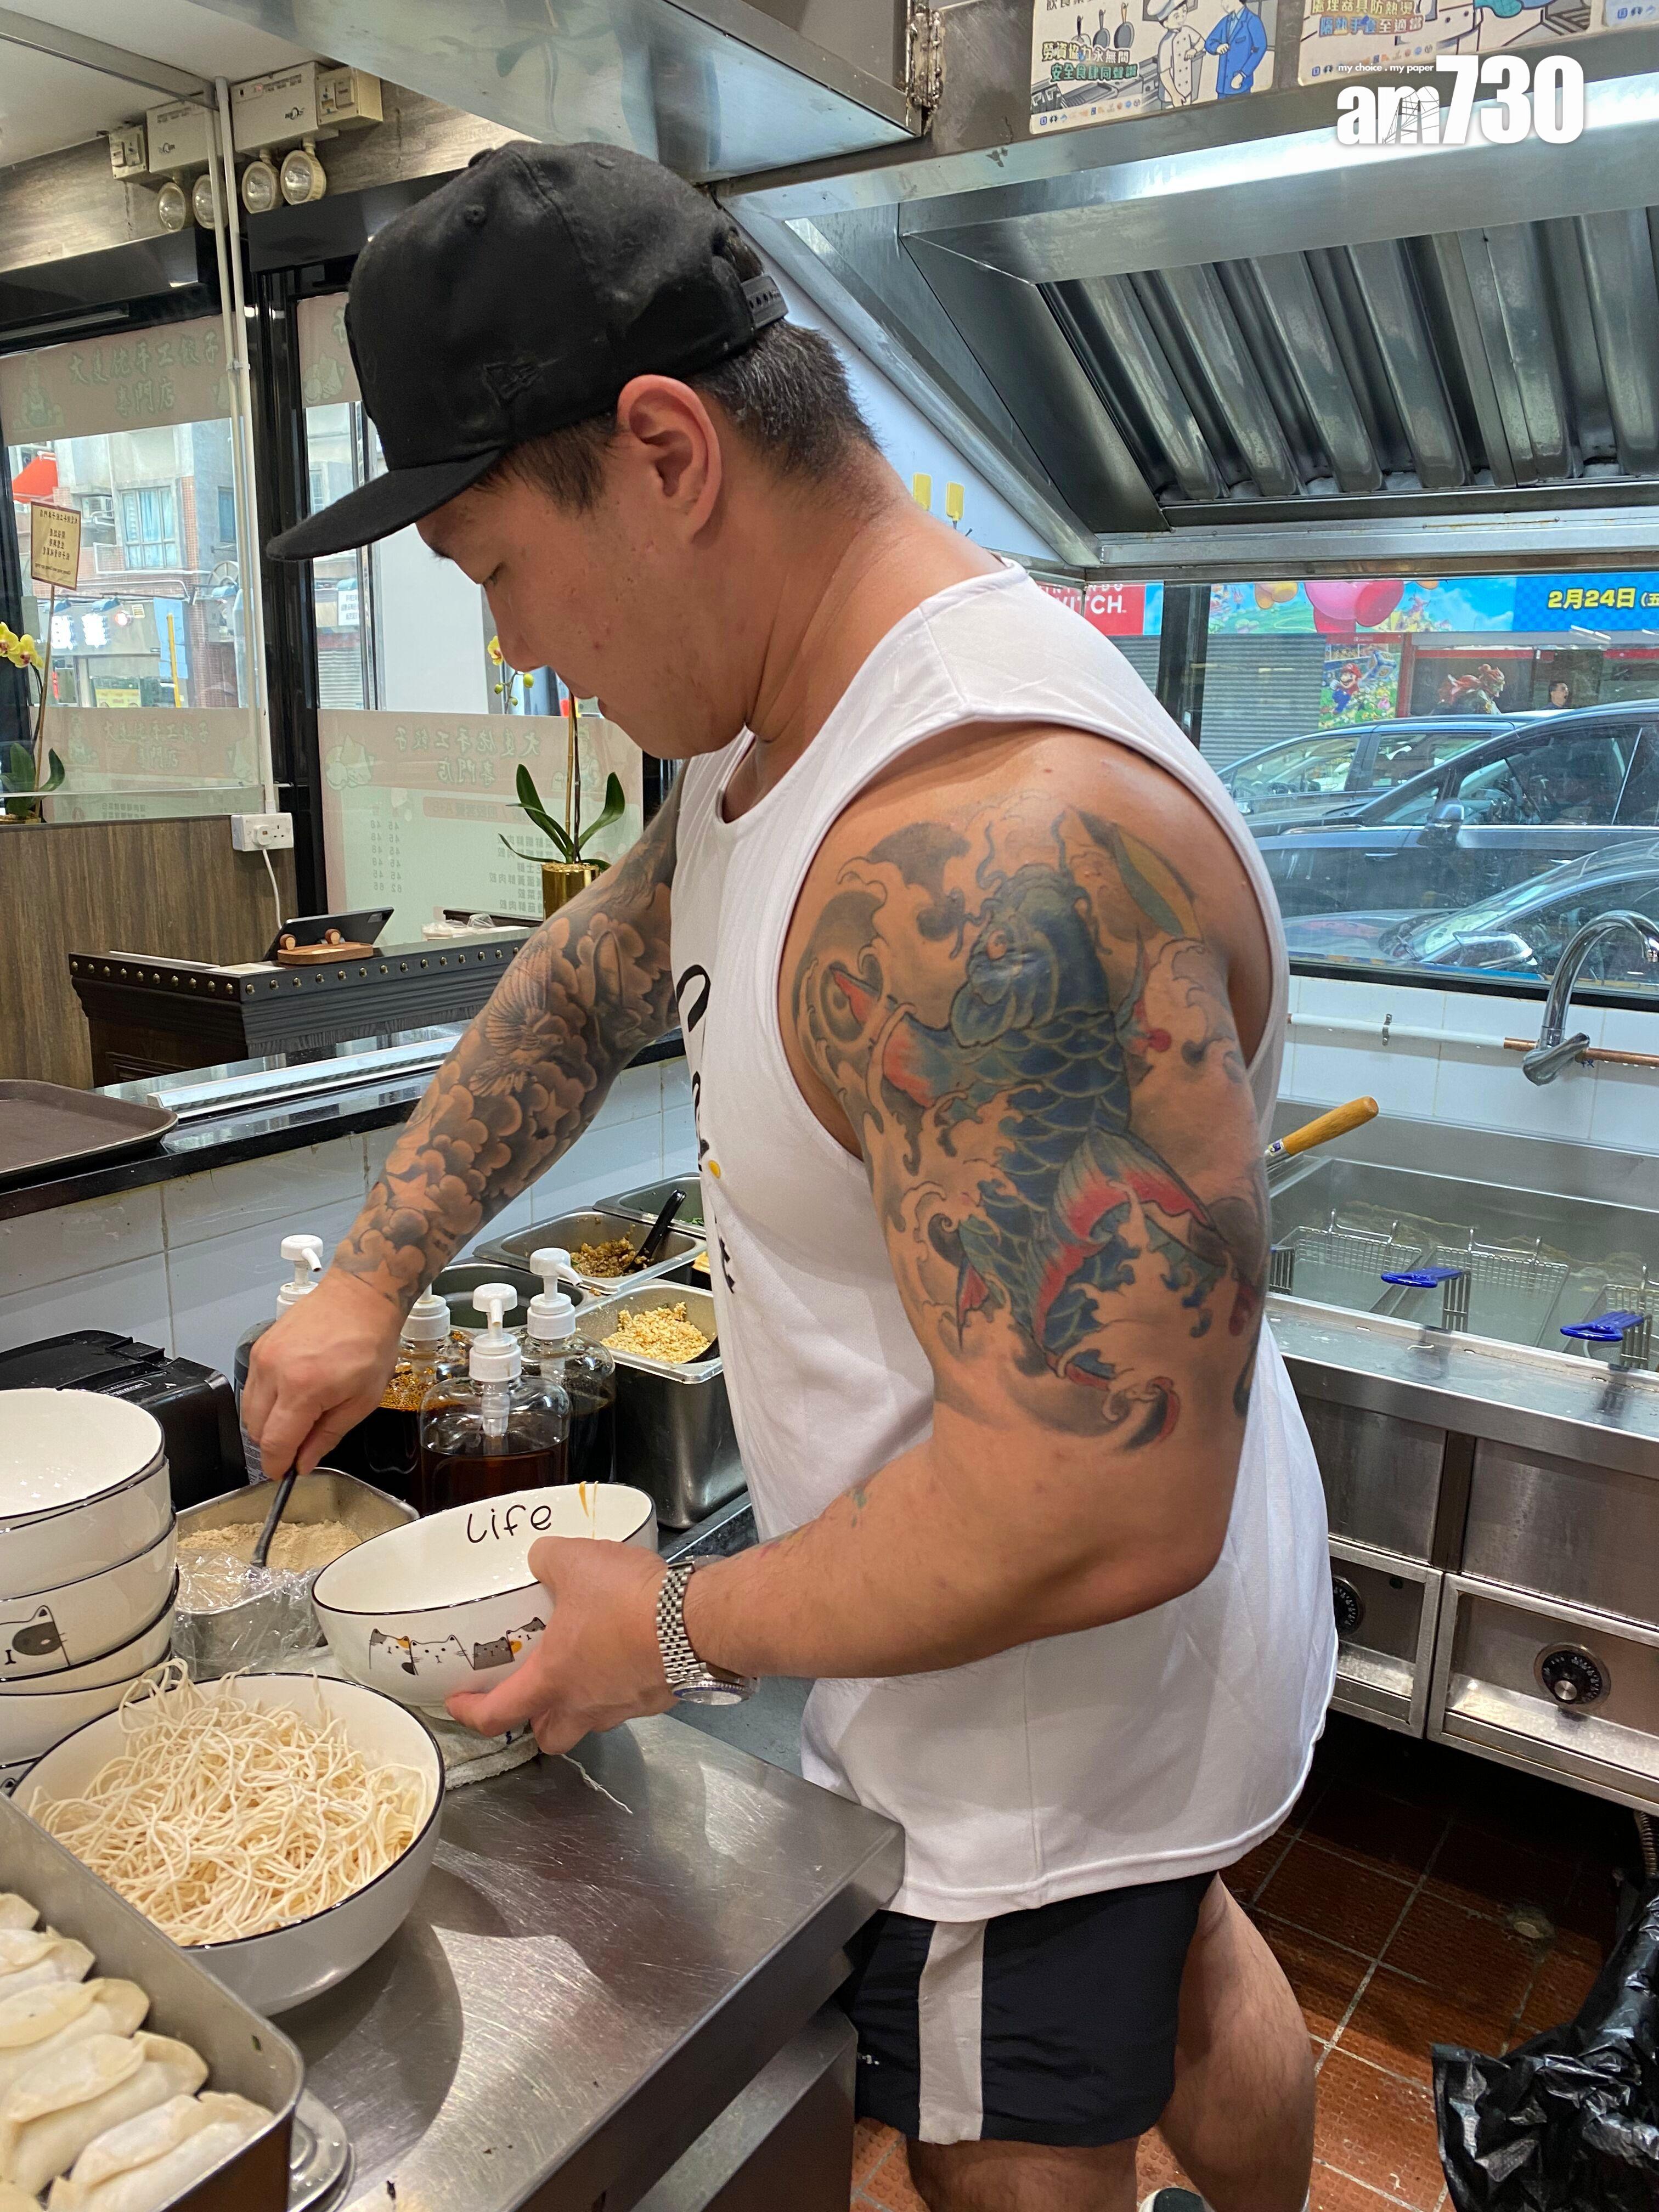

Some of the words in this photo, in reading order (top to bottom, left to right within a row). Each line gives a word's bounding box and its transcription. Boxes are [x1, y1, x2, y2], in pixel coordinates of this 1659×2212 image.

[1321, 16, 1423, 36] 隔熱手套至適當
[1042, 42, 1130, 64] 勞資協力永無間
[116, 377, 175, 416] 專門店
[467, 1504, 551, 1543] Life
